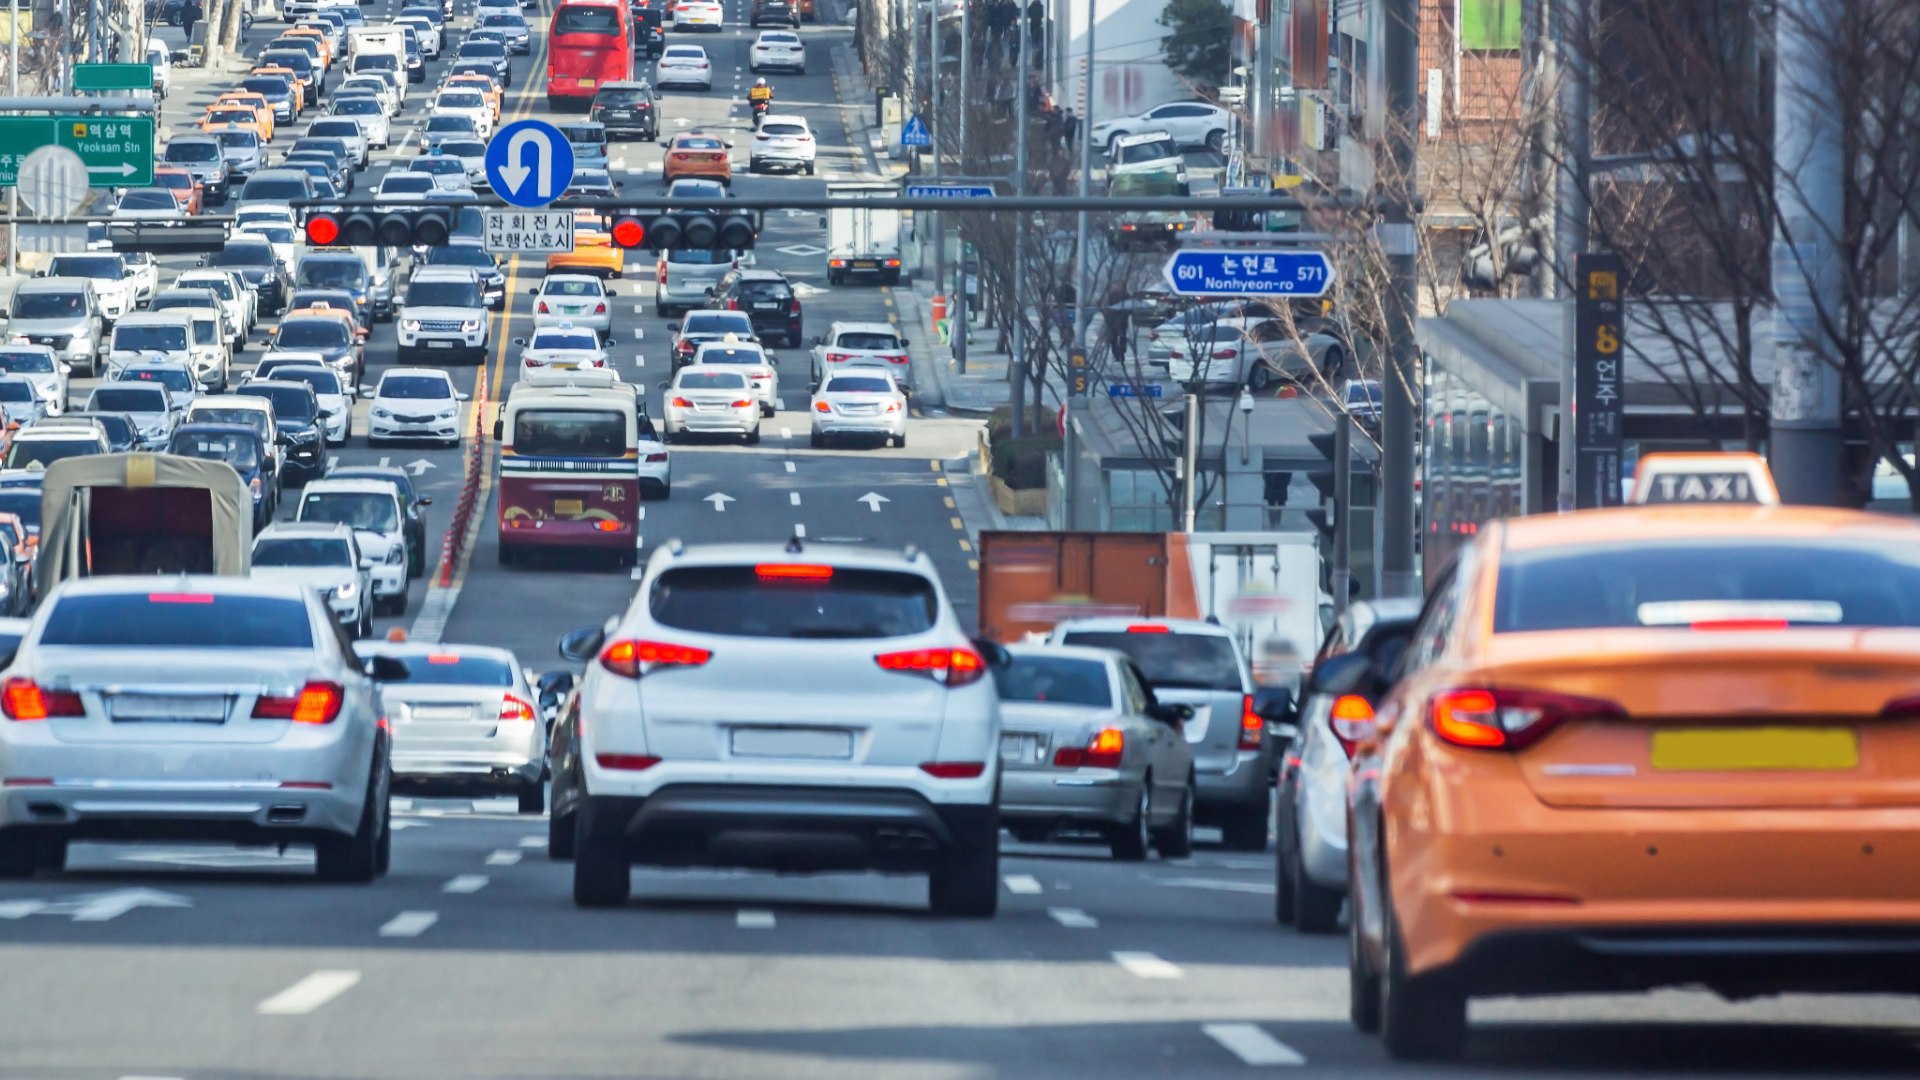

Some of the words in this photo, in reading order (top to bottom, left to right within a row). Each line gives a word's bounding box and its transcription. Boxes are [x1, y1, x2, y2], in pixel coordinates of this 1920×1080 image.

[90, 124, 131, 138] 역삼역
[77, 142, 120, 152] Yeoksam
[124, 142, 140, 152] Stn
[489, 232, 570, 249] 보행신호시
[1178, 265, 1203, 280] 601
[1222, 255, 1278, 275] 논현로
[1297, 266, 1323, 281] 571
[1205, 277, 1294, 291] Nonhyeon-ro
[1596, 324, 1618, 354] 6
[1075, 377, 1084, 391] 5
[1596, 360, 1618, 406] 언주
[1657, 474, 1748, 500] TAXI
